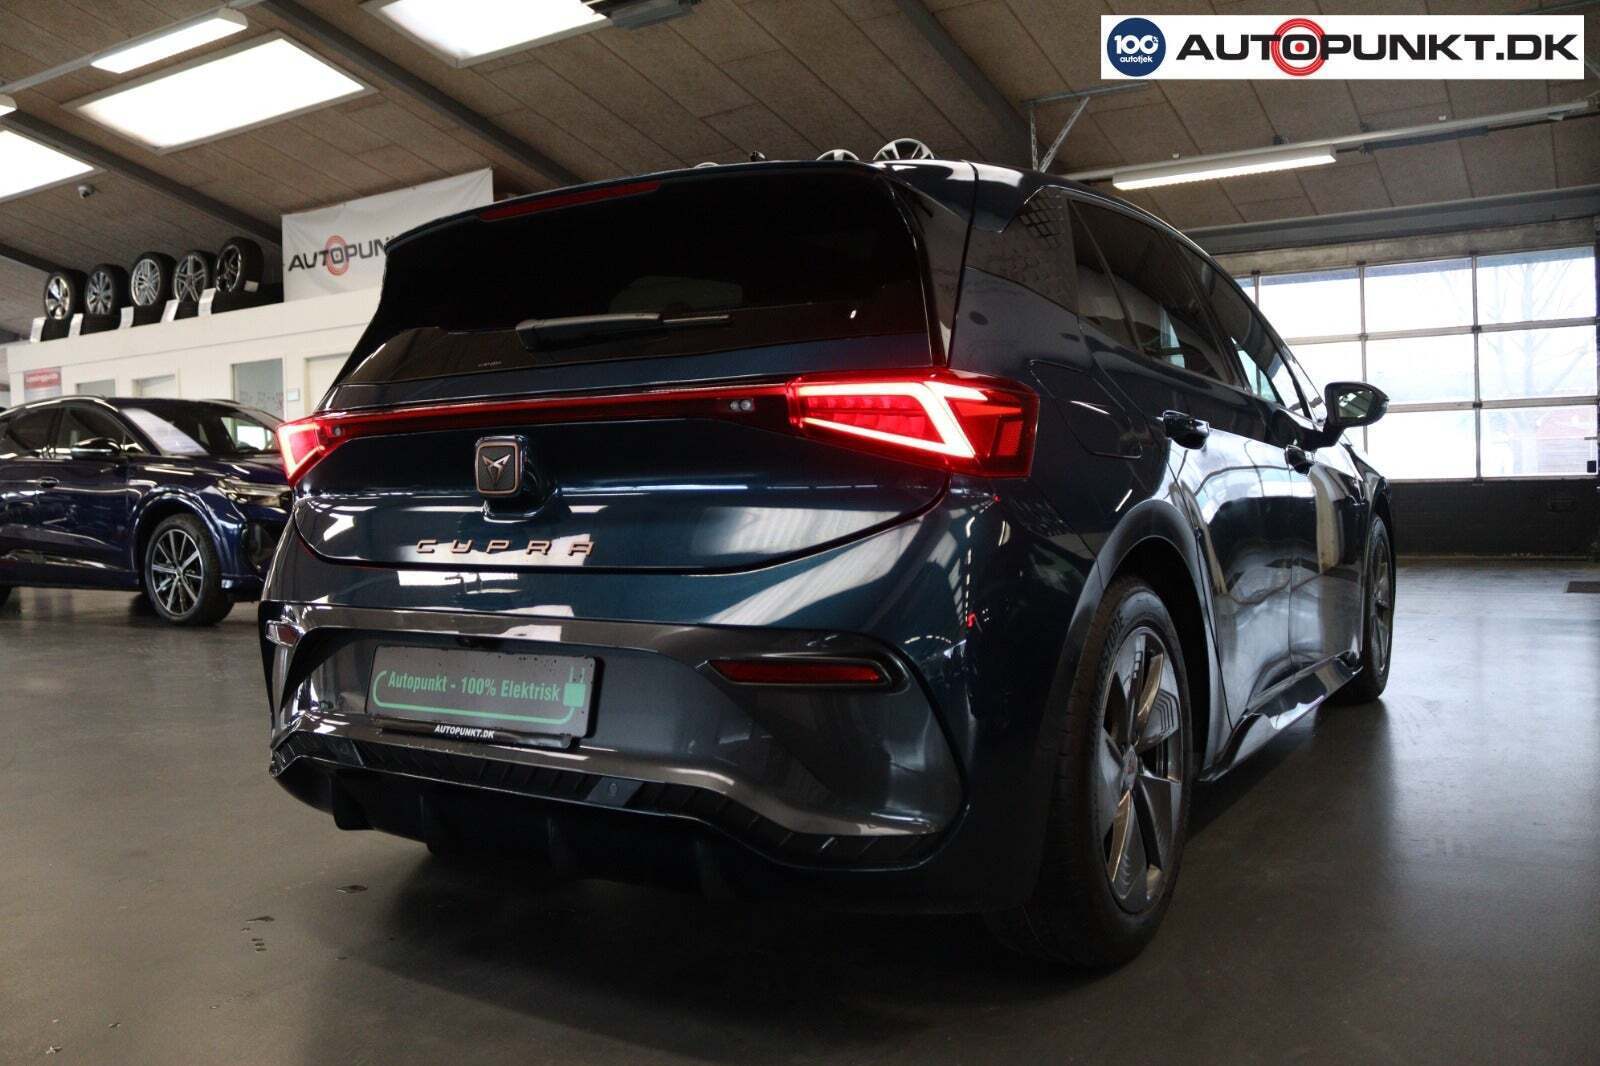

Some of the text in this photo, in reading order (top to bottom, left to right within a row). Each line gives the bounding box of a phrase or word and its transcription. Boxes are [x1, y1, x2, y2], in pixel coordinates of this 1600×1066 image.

[288, 236, 394, 272] AUTOPUN
[417, 539, 594, 557] CUPRA
[388, 671, 448, 694] Autopunkt
[461, 677, 497, 697] 100%
[501, 680, 560, 701] Elektrisk
[434, 724, 495, 739] AUTOPUNKT.DK
